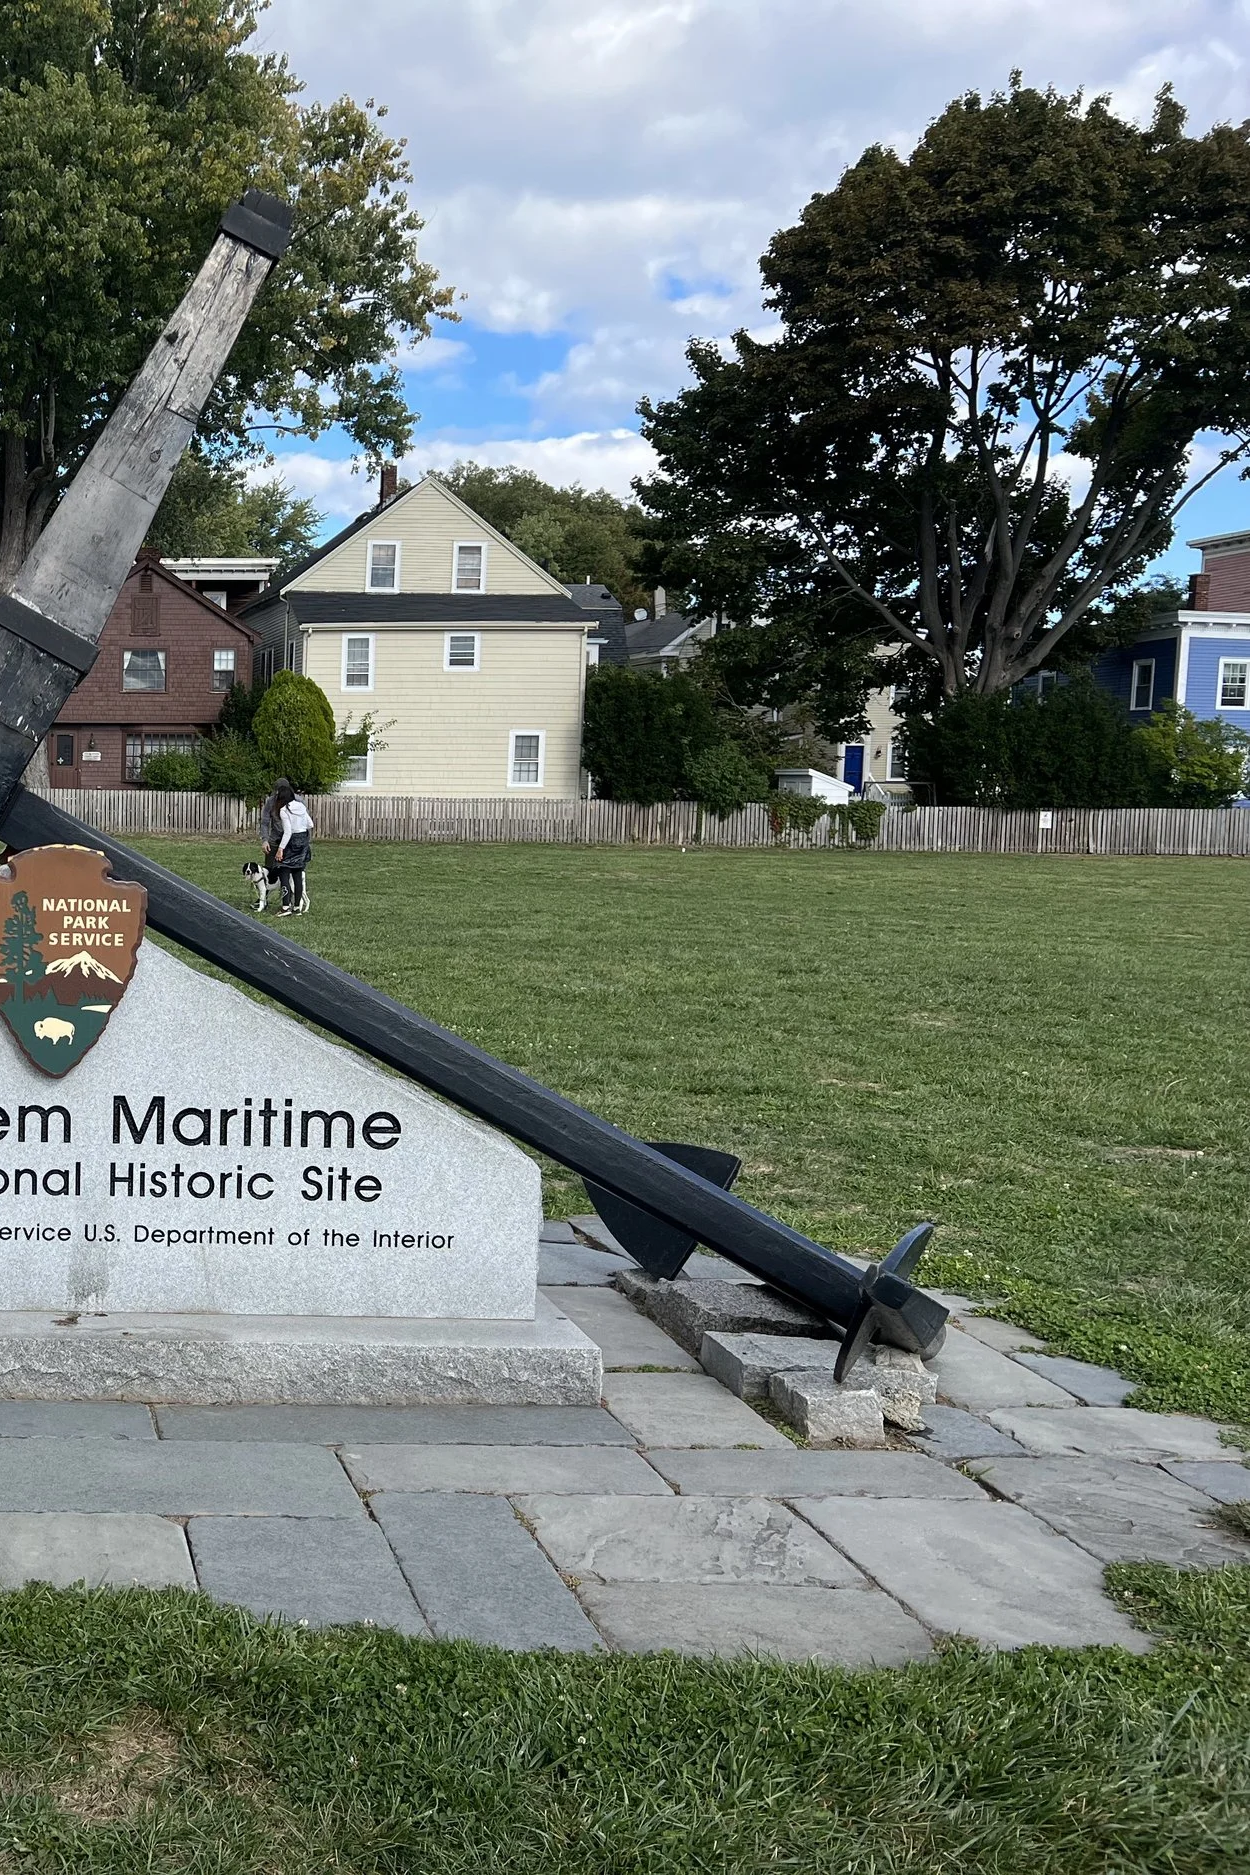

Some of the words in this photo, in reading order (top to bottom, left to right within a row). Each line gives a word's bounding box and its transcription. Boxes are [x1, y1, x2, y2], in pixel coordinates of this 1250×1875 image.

[42, 898, 132, 913] NATIONAL
[63, 915, 110, 930] PARK
[48, 932, 124, 947] SERVICE
[112, 1095, 402, 1151] Maritime
[109, 1162, 275, 1201] Historic
[300, 1165, 383, 1203] Site
[83, 1223, 121, 1243] U.S.
[134, 1224, 275, 1248] Department
[287, 1228, 310, 1246] of
[322, 1228, 360, 1248] the
[373, 1229, 455, 1250] Interior
